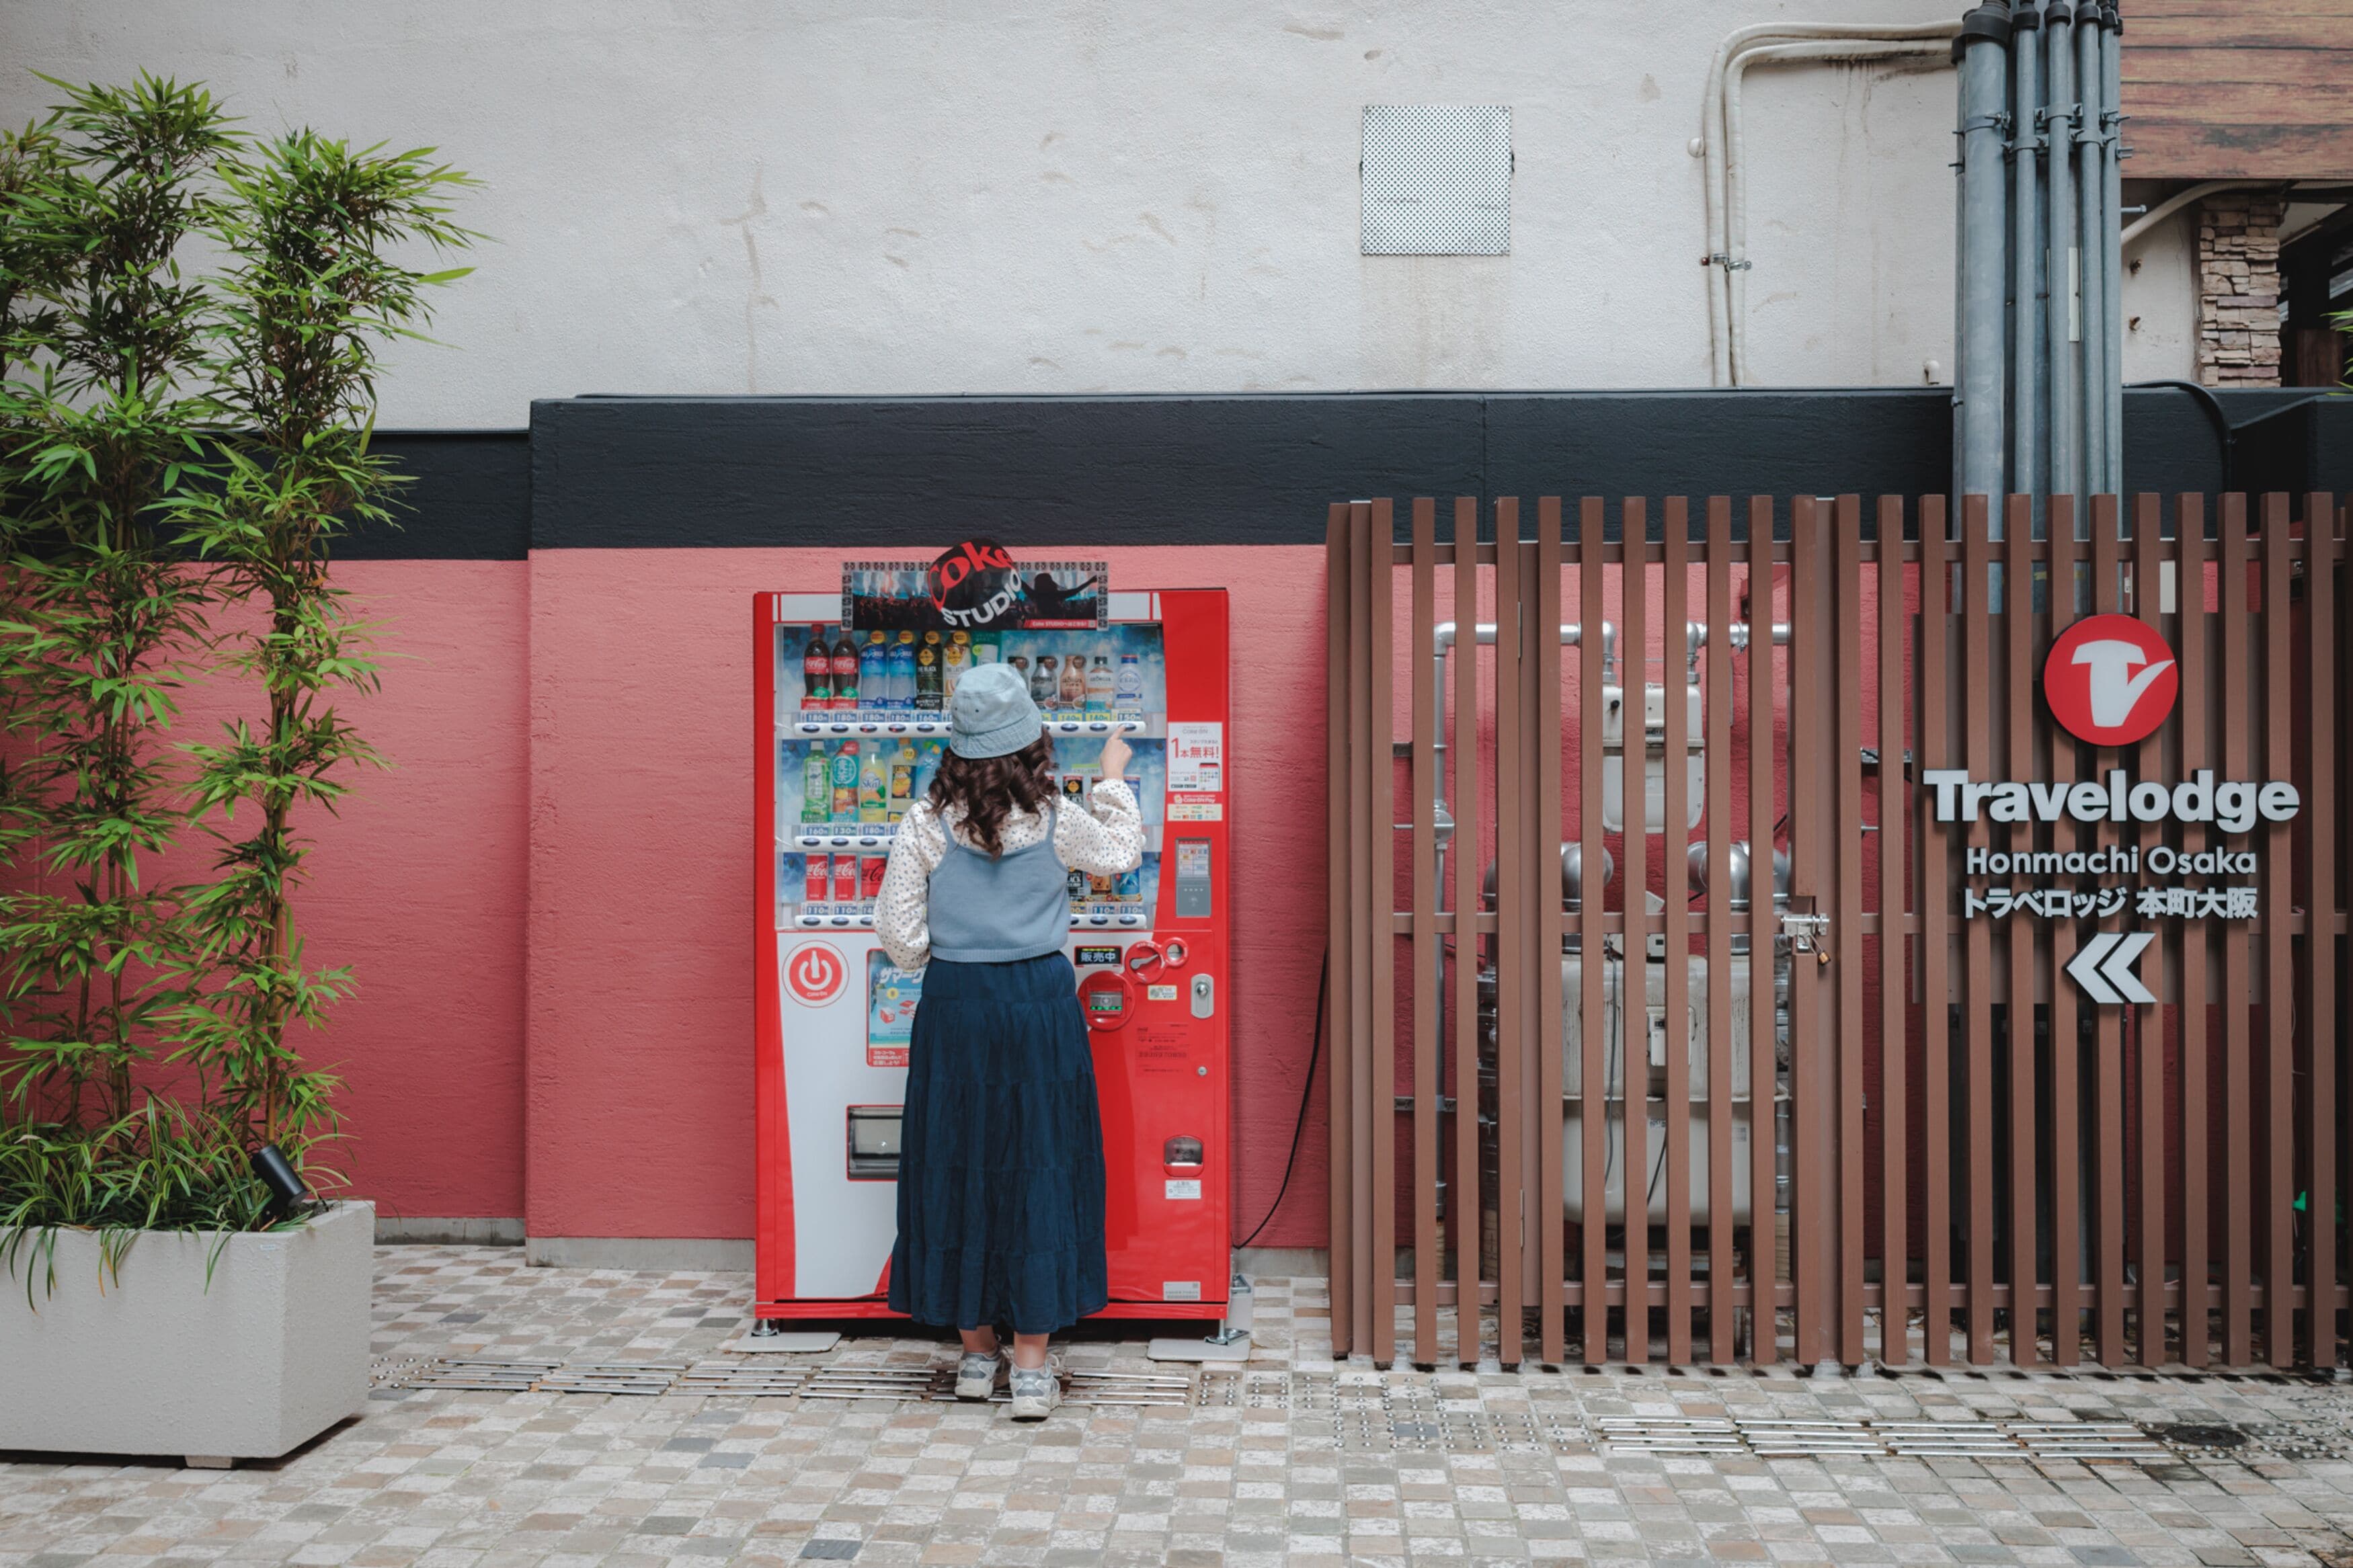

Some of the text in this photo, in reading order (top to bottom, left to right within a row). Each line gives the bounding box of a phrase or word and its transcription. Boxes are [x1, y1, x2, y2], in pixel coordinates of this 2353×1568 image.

[928, 542, 1014, 612] Coke
[941, 569, 1023, 628] STUDIO
[1171, 737, 1219, 758] 1本無料!
[1923, 770, 2300, 833] Travelodge
[1966, 845, 2257, 874] Honmachi Osaka
[1965, 886, 2258, 918] トラベロッジ 本町大阪
[1081, 952, 1116, 962] 販売中
